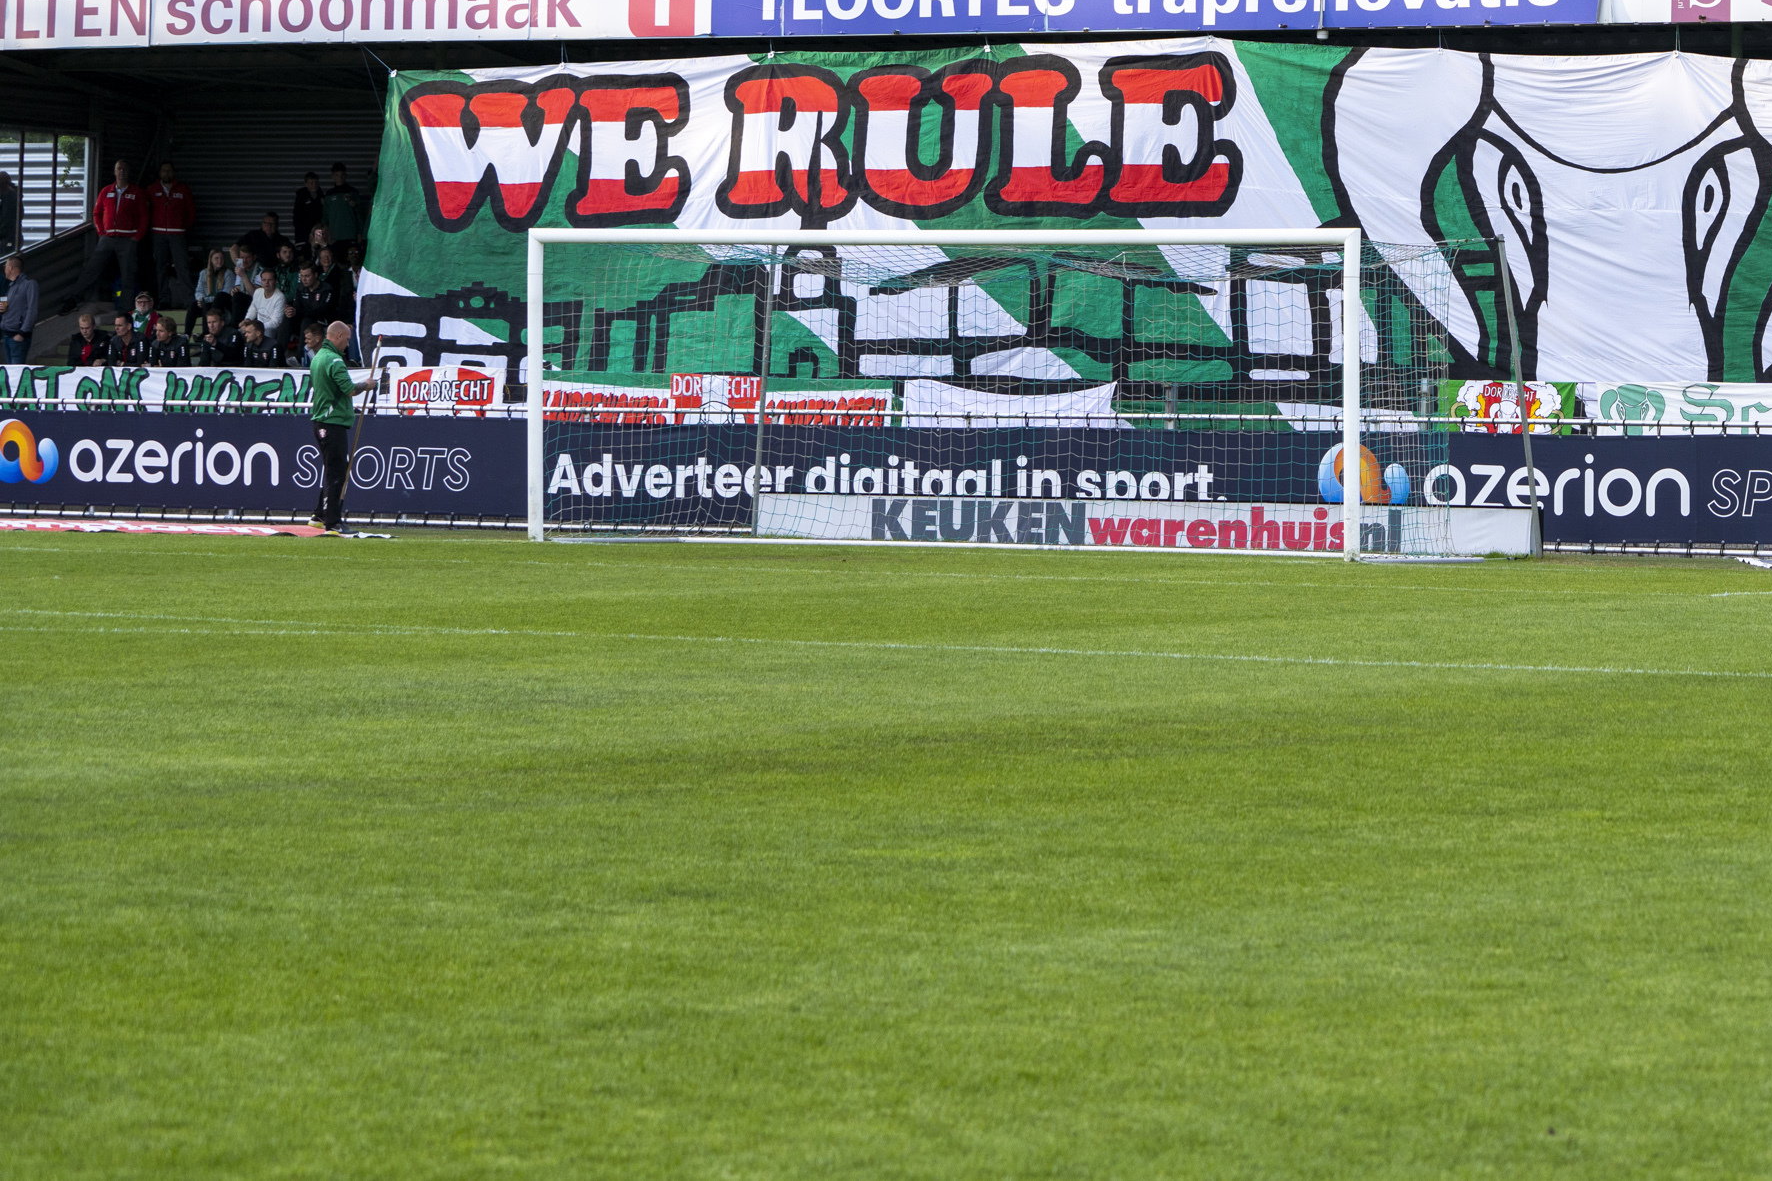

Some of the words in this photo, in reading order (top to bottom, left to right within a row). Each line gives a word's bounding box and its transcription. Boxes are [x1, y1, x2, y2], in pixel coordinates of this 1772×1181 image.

[400, 73, 690, 233] WE
[716, 53, 1244, 219] RULE
[399, 379, 492, 402] DORDRECHT
[671, 375, 761, 398] DORECHT
[1484, 385, 1534, 402] DORDREHT
[69, 428, 279, 486] azerion
[292, 444, 471, 492] SORTS
[548, 453, 794, 498] Adverteer
[805, 453, 1002, 496] digitaal
[1016, 455, 1062, 498] in
[1423, 453, 1690, 517] azerion
